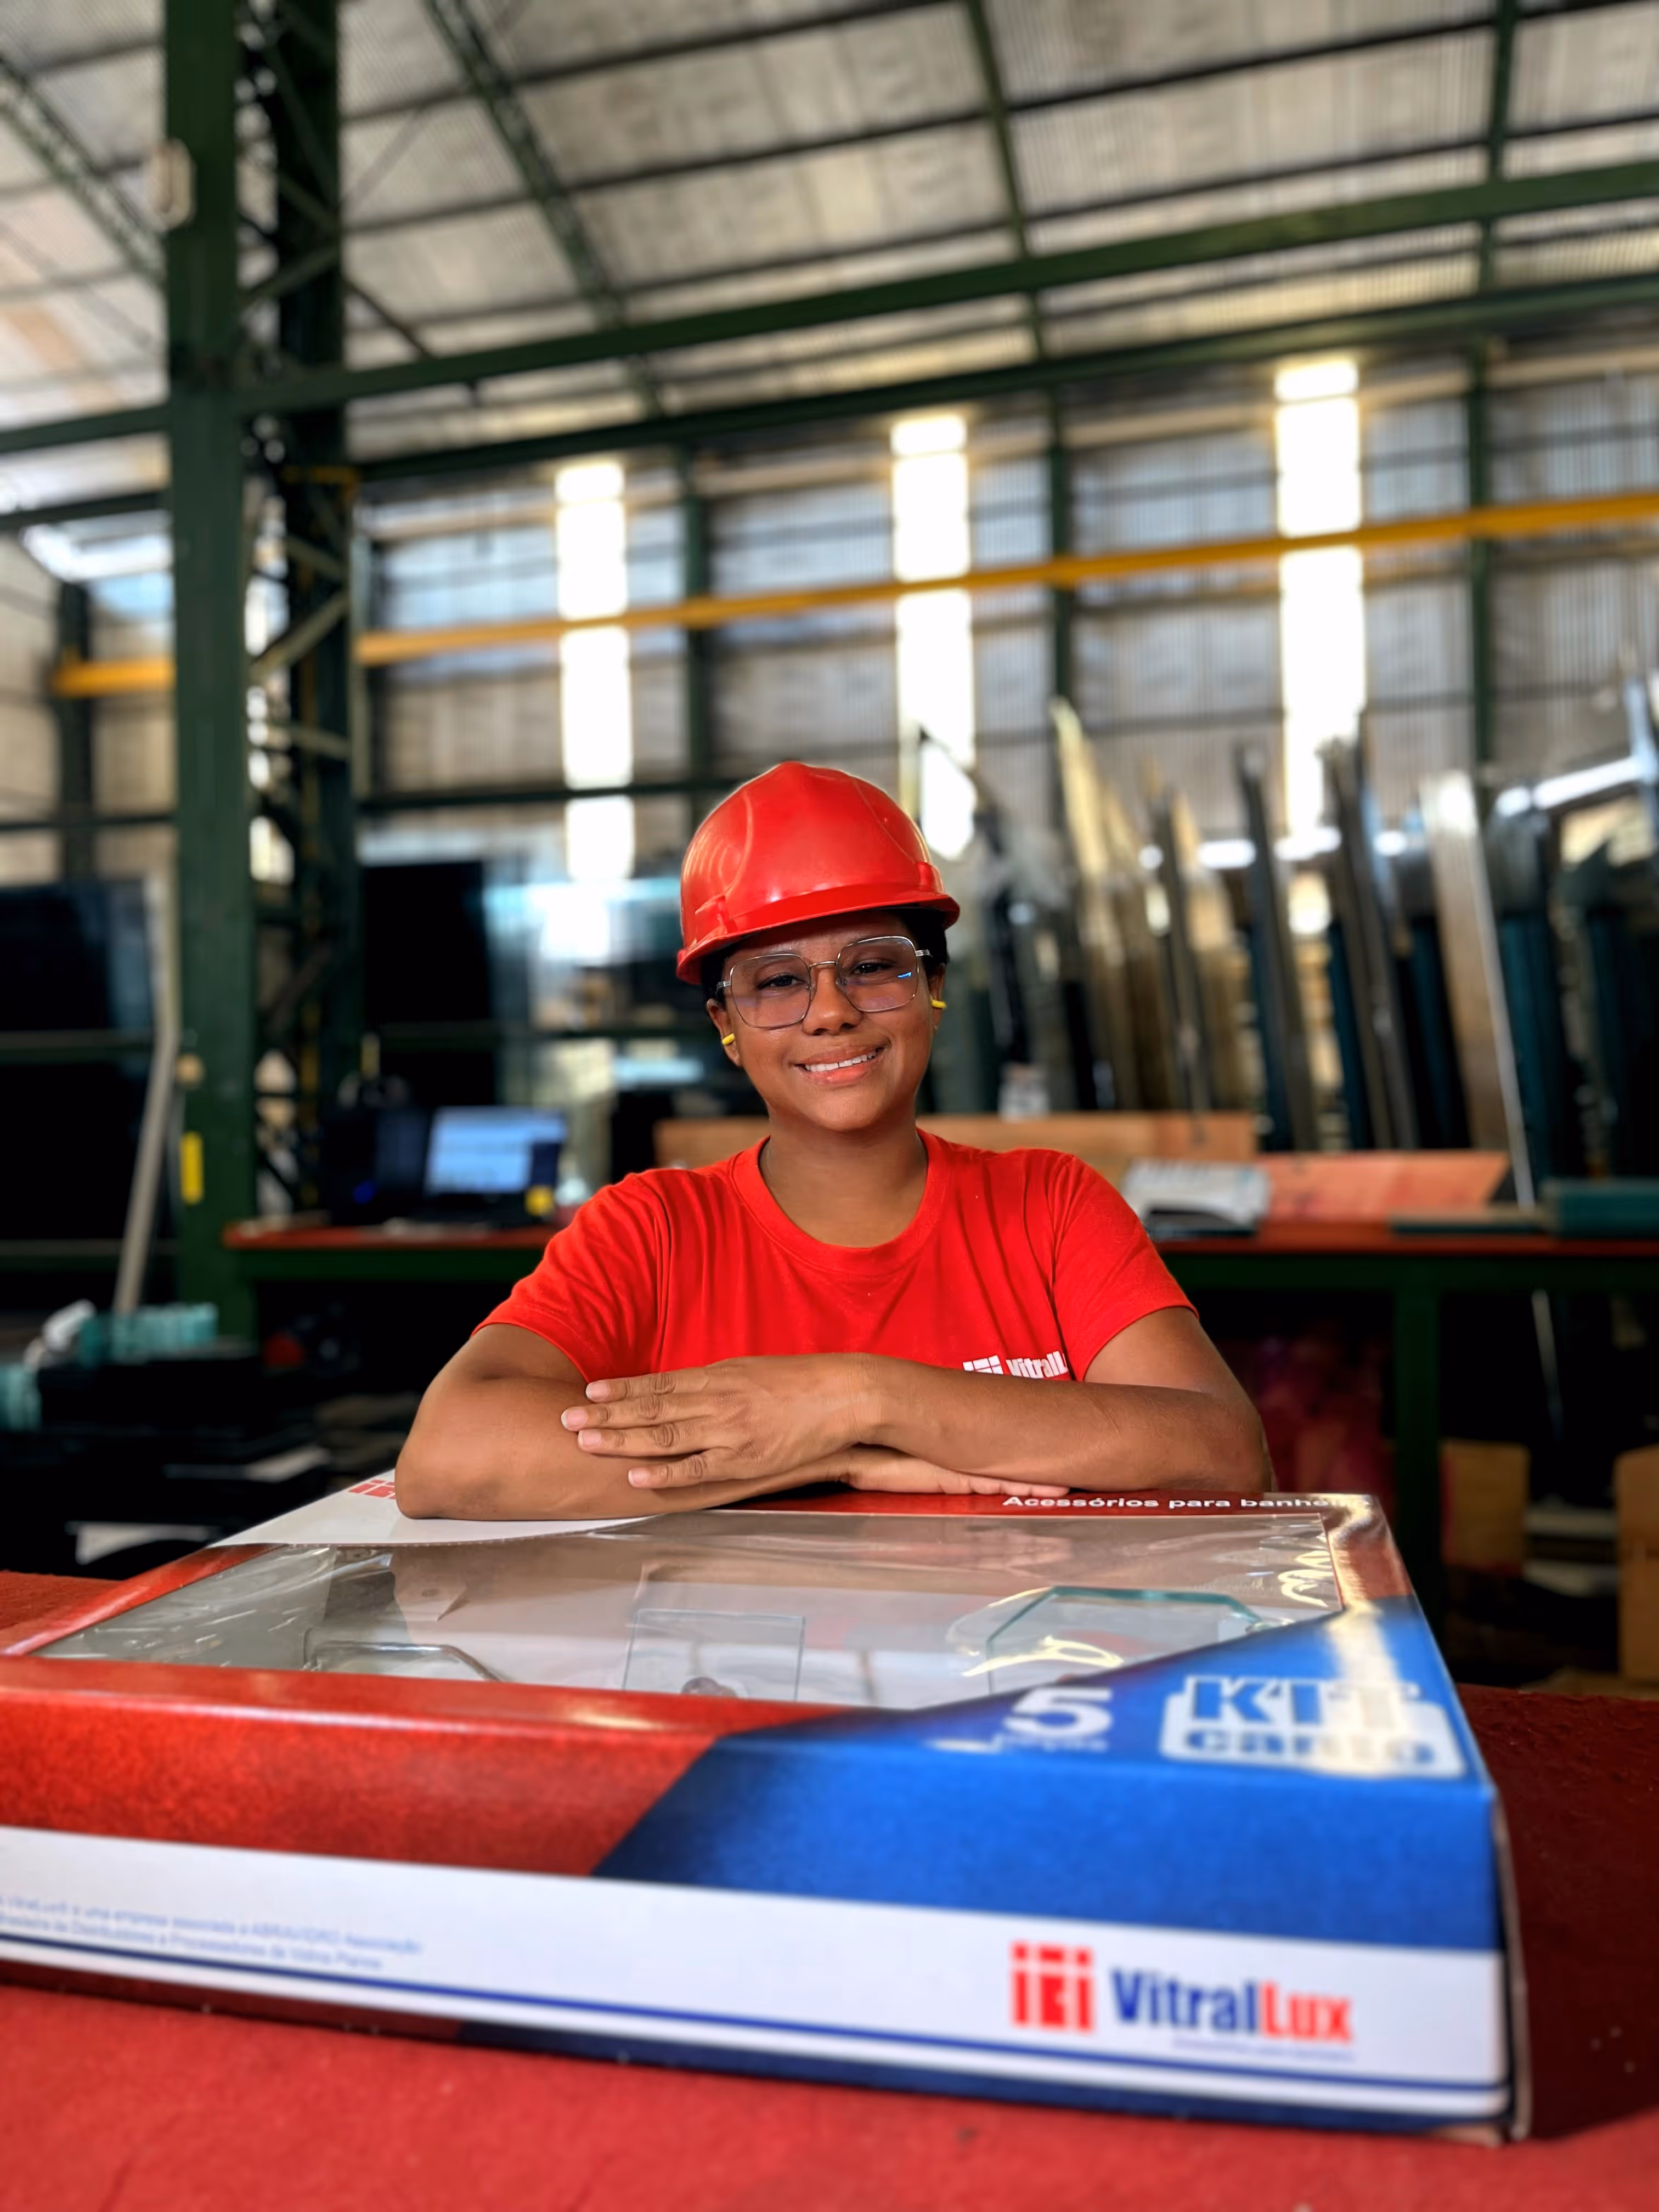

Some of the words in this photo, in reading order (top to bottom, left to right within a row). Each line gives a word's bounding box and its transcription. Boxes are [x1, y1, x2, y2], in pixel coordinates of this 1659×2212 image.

[1006, 1351, 1068, 1379] VitralL
[1002, 1496, 1159, 1507] Acessórios
[1169, 1498, 1231, 1509] para
[1003, 1686, 1113, 1737] 5
[1110, 1967, 1352, 2043] VitralLux
